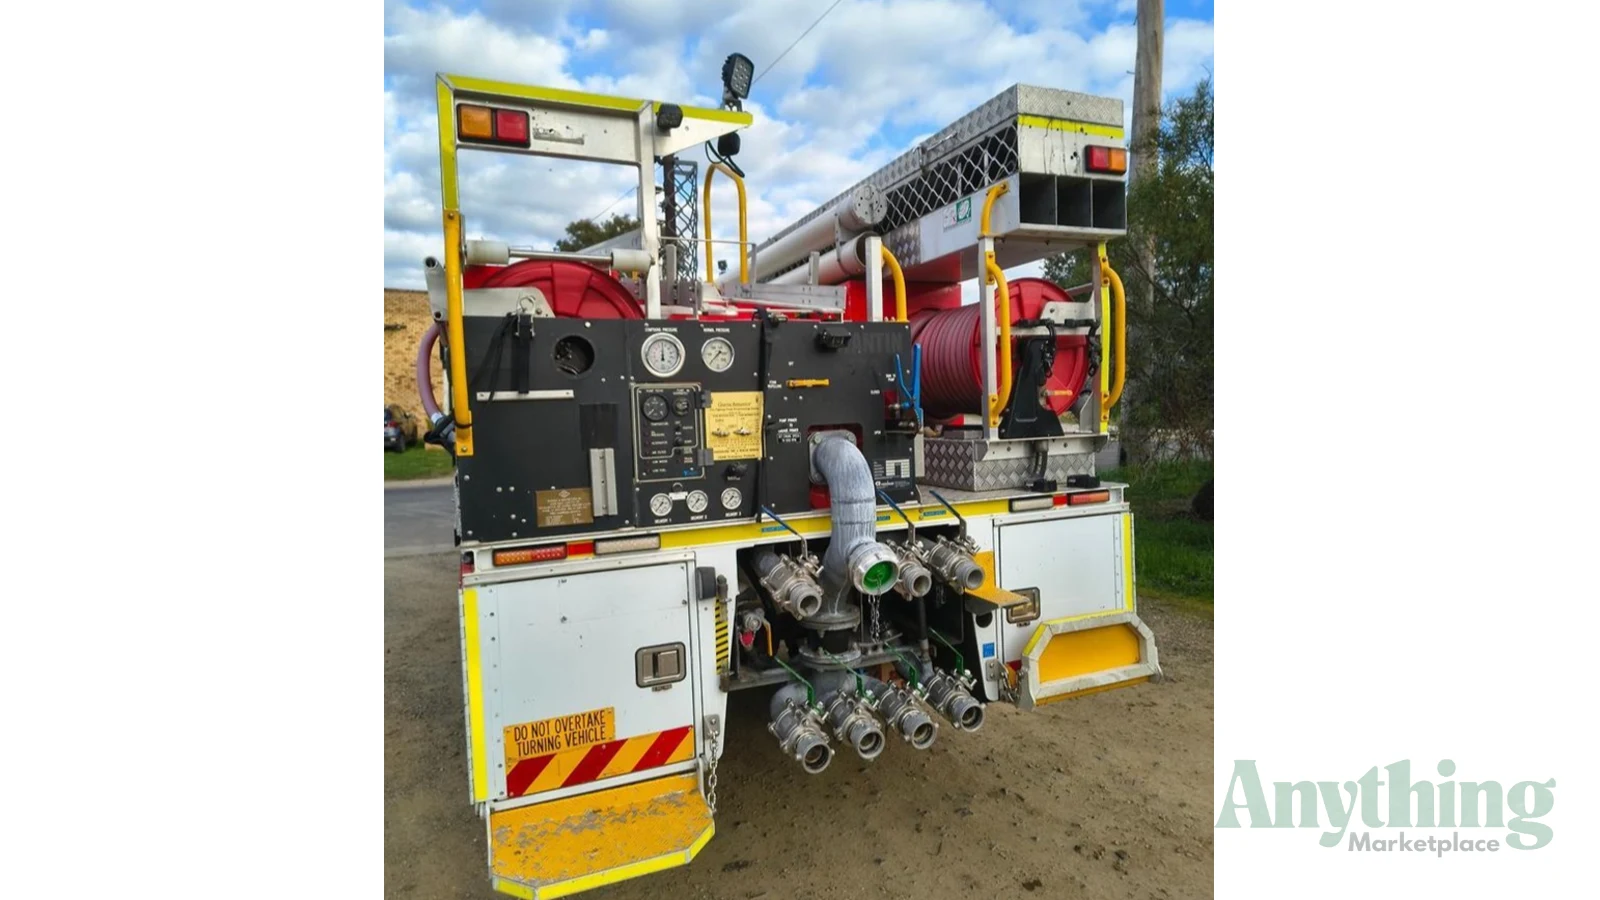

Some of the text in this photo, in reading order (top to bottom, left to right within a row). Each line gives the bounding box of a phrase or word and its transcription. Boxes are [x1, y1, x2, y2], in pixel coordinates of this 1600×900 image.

[514, 710, 606, 742] DO NOT OVERTAKE
[516, 725, 606, 757] TURNING VEHICLE
